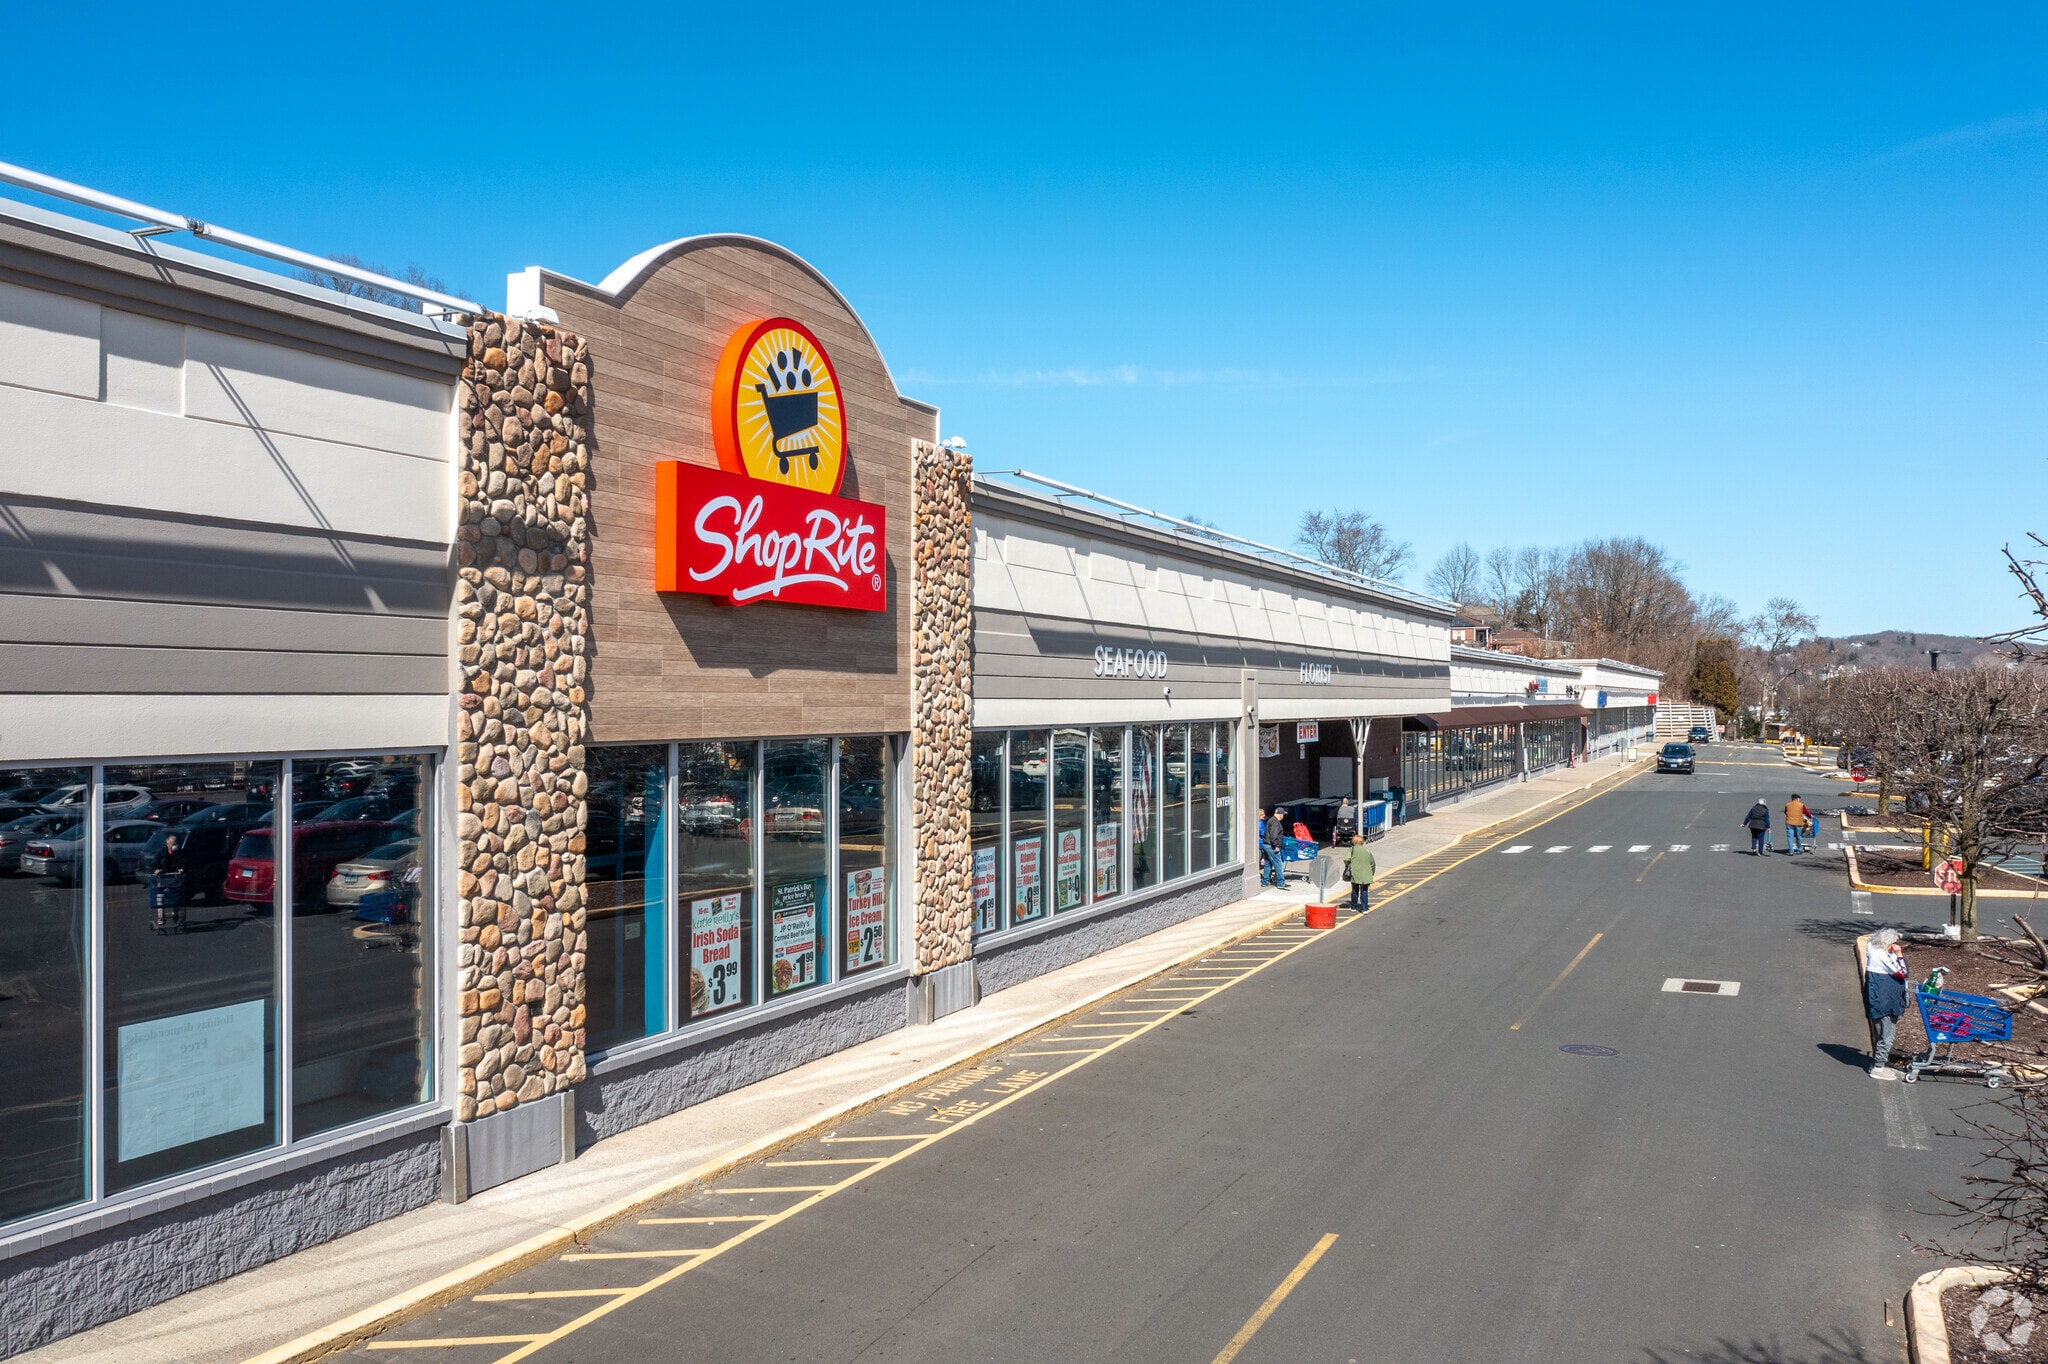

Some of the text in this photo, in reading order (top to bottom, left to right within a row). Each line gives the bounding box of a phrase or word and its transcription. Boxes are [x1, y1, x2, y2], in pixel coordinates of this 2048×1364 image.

[689, 495, 876, 600] ShopRite
[1094, 645, 1167, 679] SEAFOOD
[1300, 662, 1332, 685] FLORIST
[1299, 724, 1317, 739] ENTER
[849, 892, 882, 911] Turkey Hill
[849, 911, 882, 928] Ice Cream
[693, 925, 739, 948] Irish Soda
[703, 943, 730, 964] Bread
[881, 1065, 1004, 1116] NO PARKING
[925, 1069, 1048, 1123] FIRE LANE
